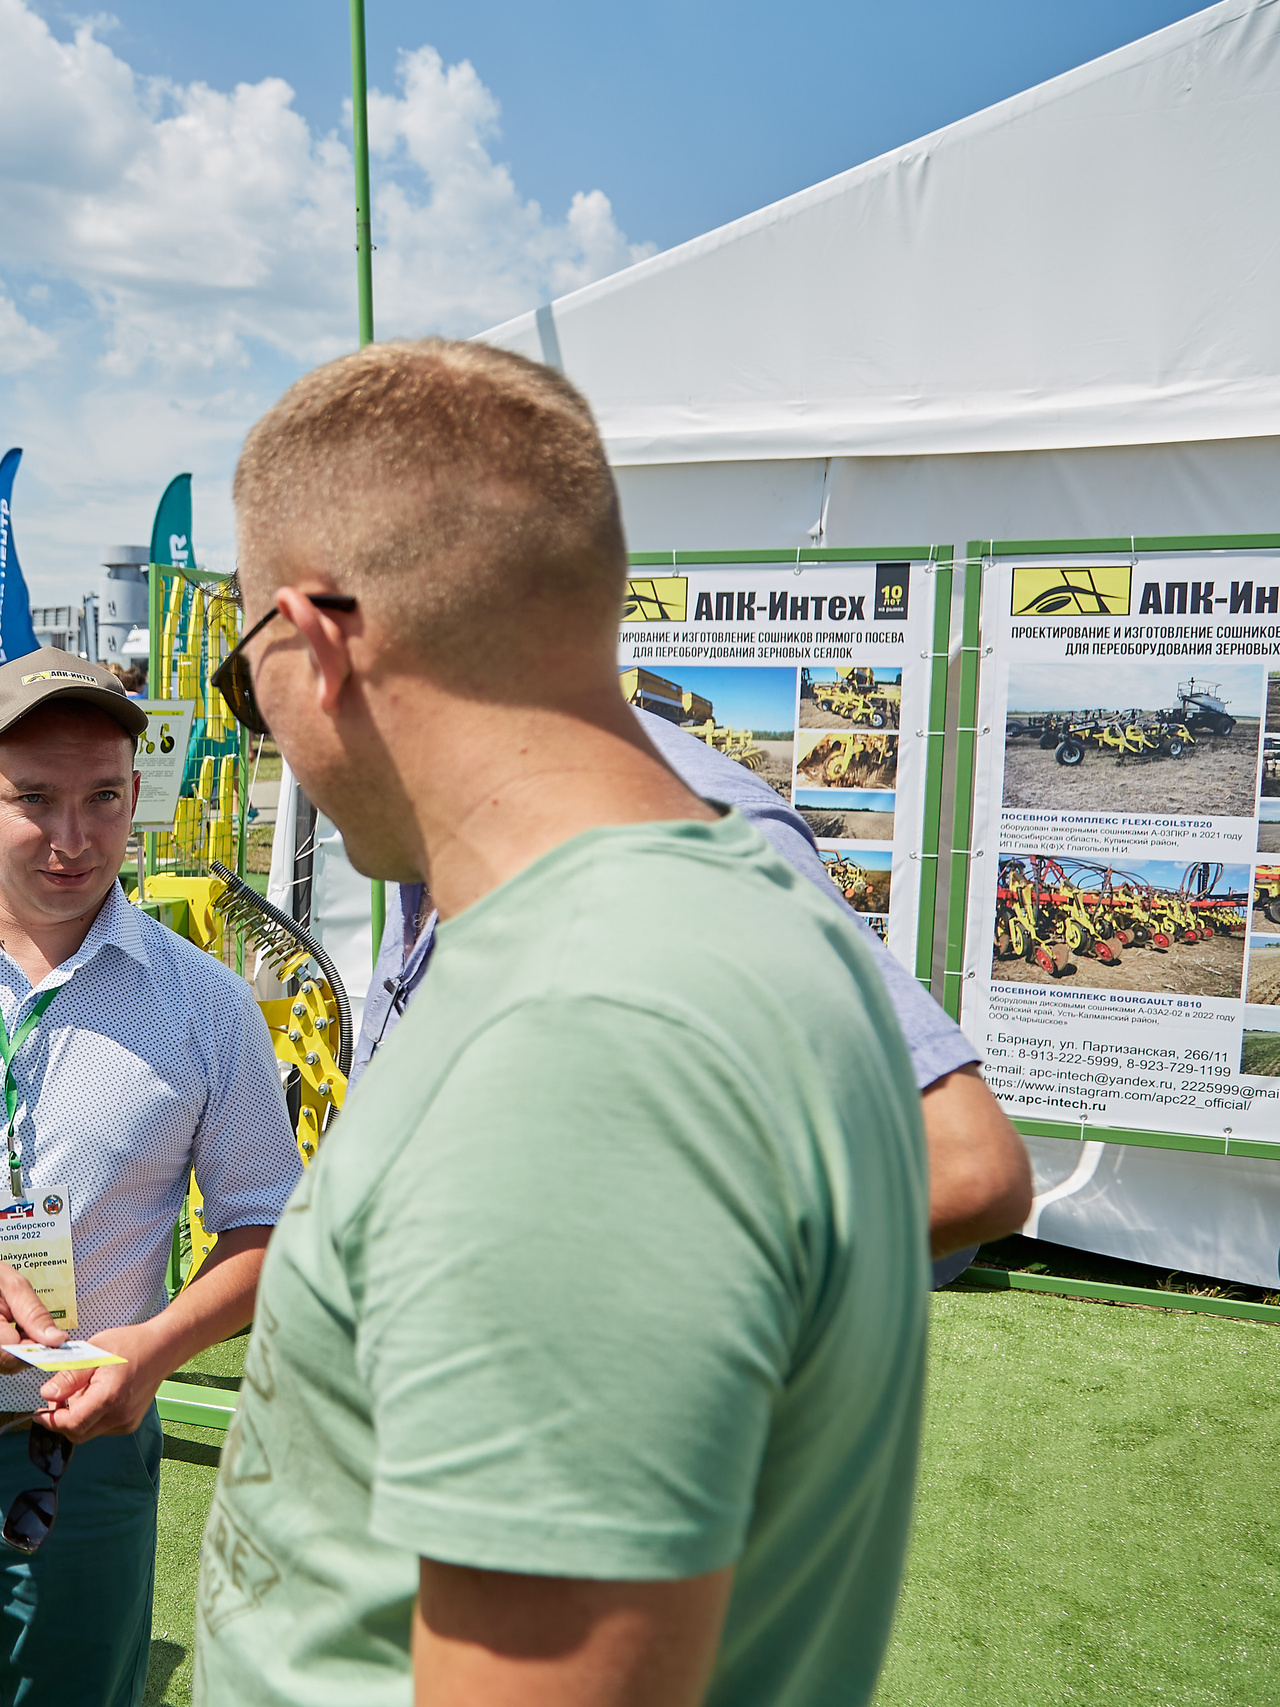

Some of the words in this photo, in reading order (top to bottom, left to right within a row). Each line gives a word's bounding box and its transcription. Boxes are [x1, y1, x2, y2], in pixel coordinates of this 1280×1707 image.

[881, 585, 903, 599] 10
[1138, 581, 1280, 614] АПК-Ин
[694, 591, 866, 621] АПК-Интех
[673, 632, 680, 643] И
[682, 632, 756, 643] ИЗГОТОВЛЕНИЕ
[758, 632, 813, 643] СОШНИКОВ
[816, 632, 862, 643] ПРЯМОГО
[865, 632, 905, 643] ПОСЕВА
[1011, 626, 1110, 639] ПРОЕКТИРОВАНИЕ
[1113, 626, 1121, 638] И
[1124, 626, 1213, 639] ИЗГОТОВЛЕНИЕ
[633, 647, 653, 659] ДЛЯ
[655, 647, 755, 659] ПЕРЕОБОРУДОВАНИЯ
[758, 647, 811, 658] ЗЕРНОВЫХ
[813, 647, 853, 658] СЕЯЛОК
[1065, 643, 1090, 656] ДЛЯ
[1092, 643, 1213, 656] ПЕРЕОБОРУДОВАНИЯ
[1215, 642, 1280, 655] ЗЕРНОВЫХ
[51, 671, 96, 683] АПК-ИНТЕХ
[1001, 813, 1058, 823] ПОСЕВНОЙ
[1061, 816, 1119, 825] КОМПЛЕКС
[1122, 818, 1213, 829] FLEXI-COILST820
[1000, 823, 1049, 833] оборудован
[1051, 826, 1098, 834] анкерными
[1100, 828, 1149, 836] сошниками
[1200, 831, 1220, 839] 2021
[1223, 833, 1243, 841] году
[1000, 832, 1063, 841] Новосибирская
[1065, 835, 1101, 844] область,
[1104, 837, 1148, 845] Купинский
[1151, 839, 1179, 847] район,
[1040, 843, 1065, 851] К(Ф)Х
[990, 986, 1047, 997] ПОСЕВНОЙ
[1050, 990, 1107, 1001] КОМПЛЕКС
[1110, 995, 1174, 1006] BOURGAULT
[1176, 1000, 1202, 1008] 8810
[989, 996, 1038, 1006] оборудован
[1039, 1000, 1086, 1010] дисковыми
[1088, 1004, 1136, 1013] сошниками
[1138, 1007, 1183, 1017] А-03А2-02
[1193, 1011, 1214, 1020] 2022
[1216, 1014, 1236, 1022] году
[989, 1004, 1032, 1014] Алтайский
[1034, 1008, 1055, 1017] край,
[1057, 1010, 1129, 1022] Усть-Калманский
[1131, 1015, 1159, 1025] район,
[988, 1012, 1009, 1020] ООО
[1012, 1013, 1068, 1025] «Чарышское»
[986, 1033, 993, 1042] г.
[997, 1032, 1055, 1049] Барнаул,
[1059, 1040, 1078, 1051] ул.
[1082, 1040, 1179, 1060] Партизанская,
[1184, 1048, 1229, 1063] 266/11
[986, 1047, 1014, 1058] тел.:
[1018, 1048, 1122, 1069] 8-913-222-5999,
[1126, 1058, 1232, 1078] 8-923-729-1199
[984, 1063, 1025, 1076] e-mail:
[1029, 1068, 1176, 1091] apc-intech@yandex.ru,
[983, 1075, 1252, 1111] https://www.instagram.com/apc22_official/
[6, 1221, 56, 1232] сибирского
[21, 1231, 41, 1240] 2022
[24, 1258, 68, 1270] Сергеевич
